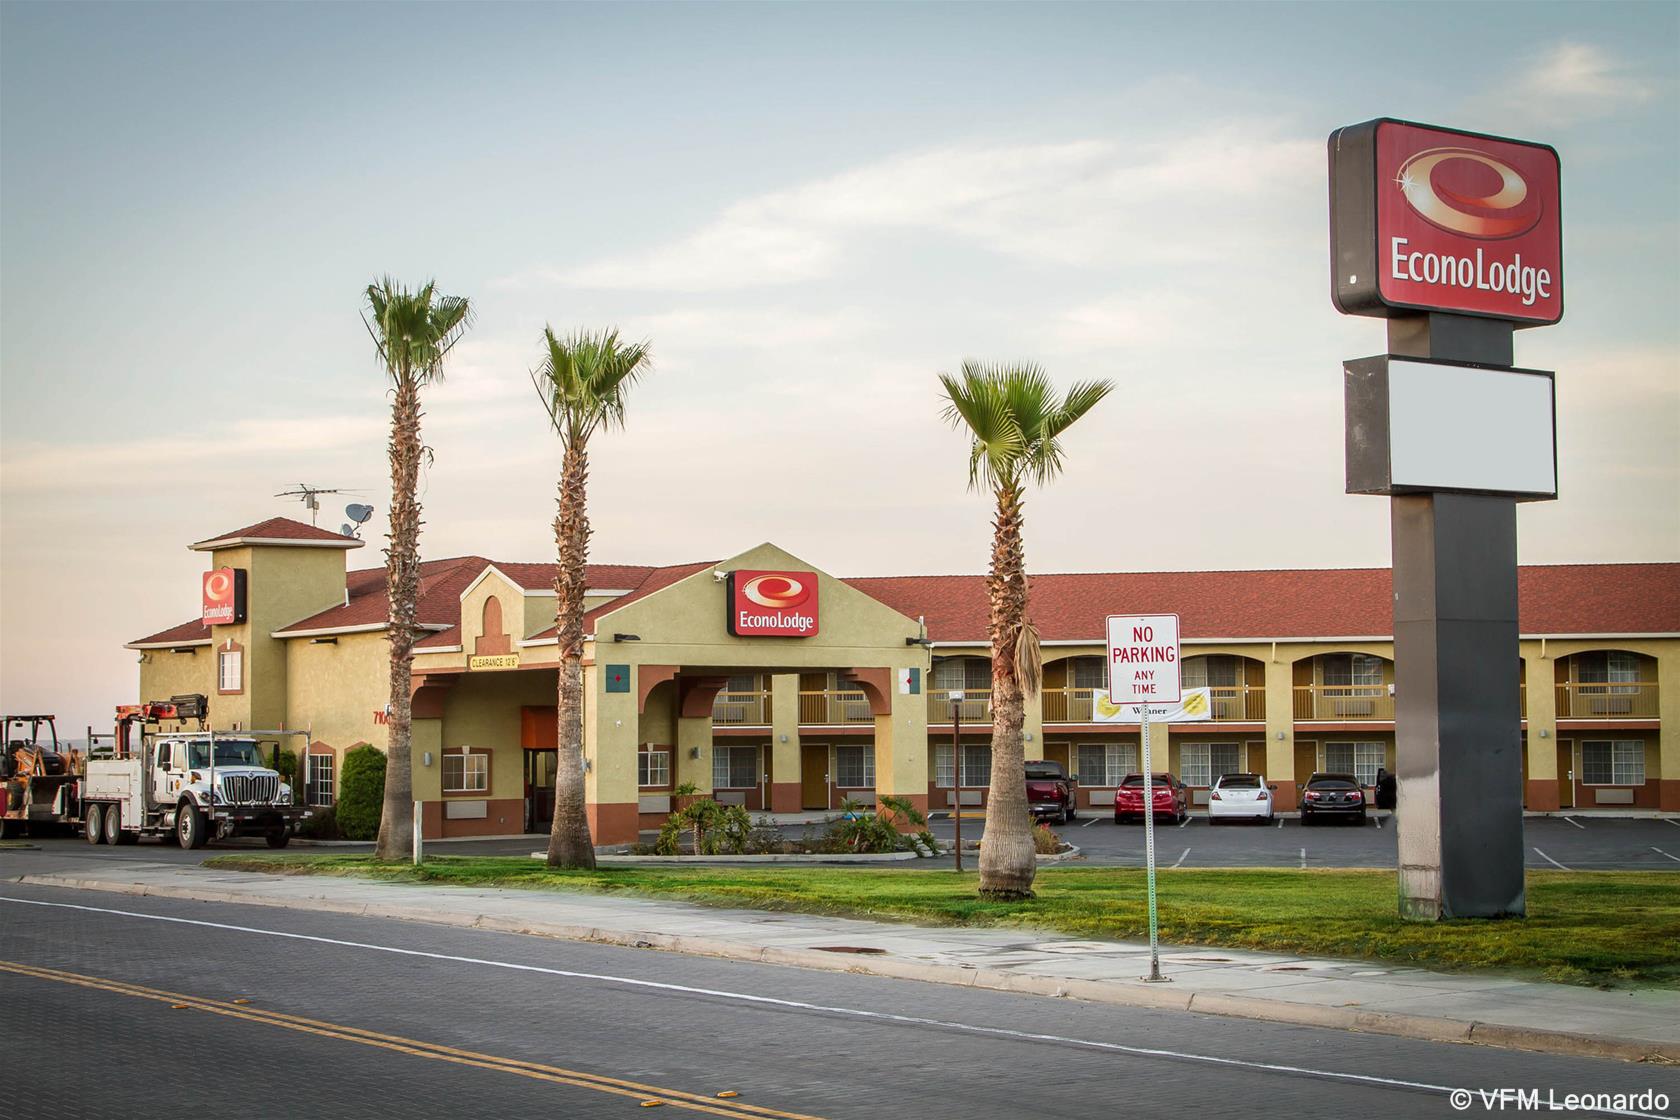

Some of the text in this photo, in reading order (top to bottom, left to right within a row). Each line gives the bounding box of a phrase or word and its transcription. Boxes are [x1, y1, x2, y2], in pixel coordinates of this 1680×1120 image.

[1391, 236, 1551, 306] EconoLodge
[204, 603, 233, 620] EconoLodge
[739, 610, 814, 632] EconoLodge
[1133, 626, 1153, 643] NO
[472, 657, 503, 668] CLEARANCE
[1112, 646, 1175, 664] PARKING
[1134, 670, 1155, 680] ANY
[1132, 683, 1157, 694] TIME
[1132, 706, 1168, 715] Wner
